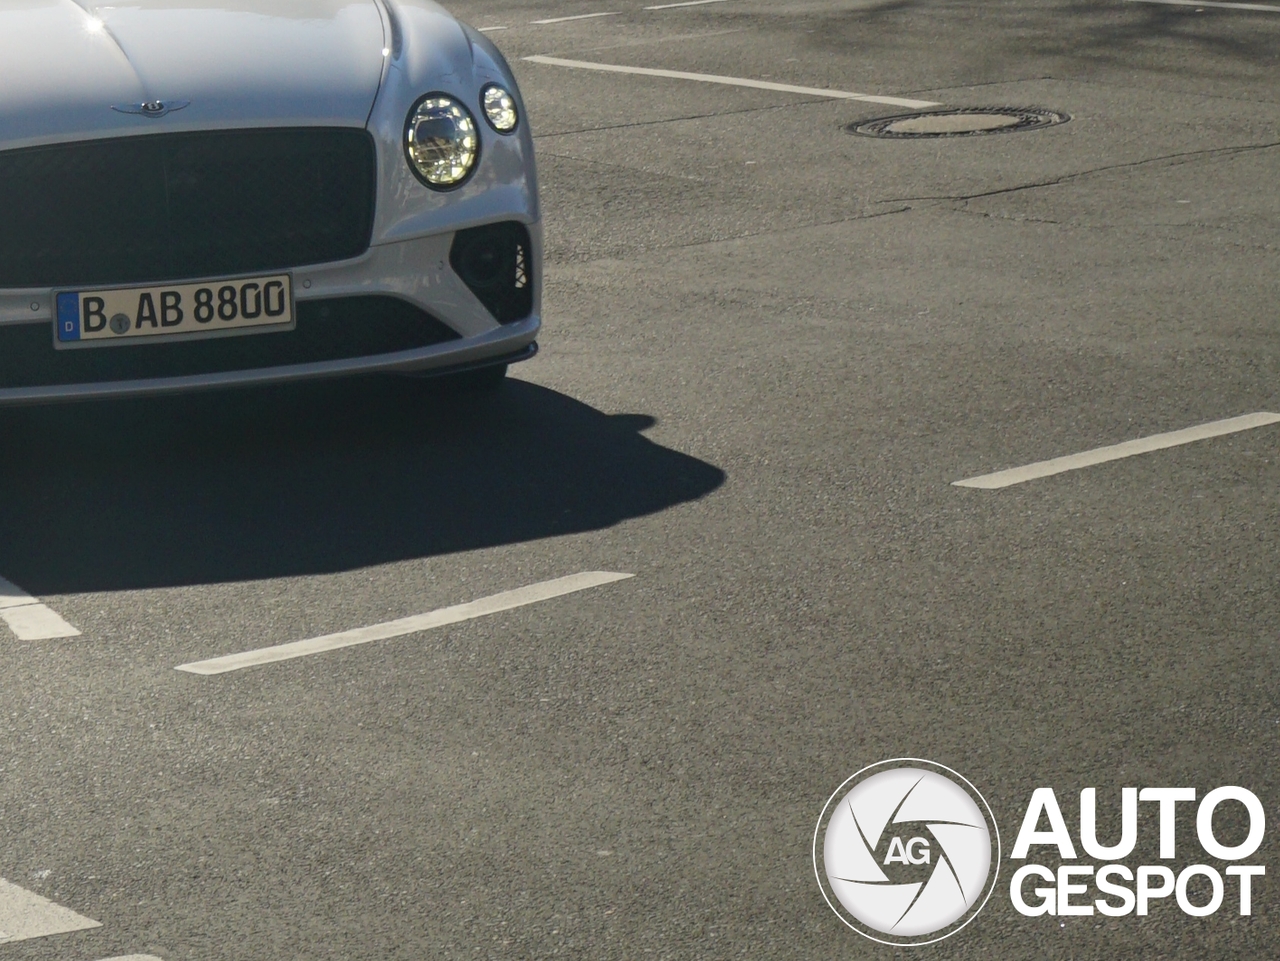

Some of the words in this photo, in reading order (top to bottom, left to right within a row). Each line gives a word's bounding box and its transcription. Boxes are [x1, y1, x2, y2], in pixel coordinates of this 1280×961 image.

[82, 296, 107, 333] B
[135, 291, 184, 329] AB
[193, 280, 285, 324] 8800
